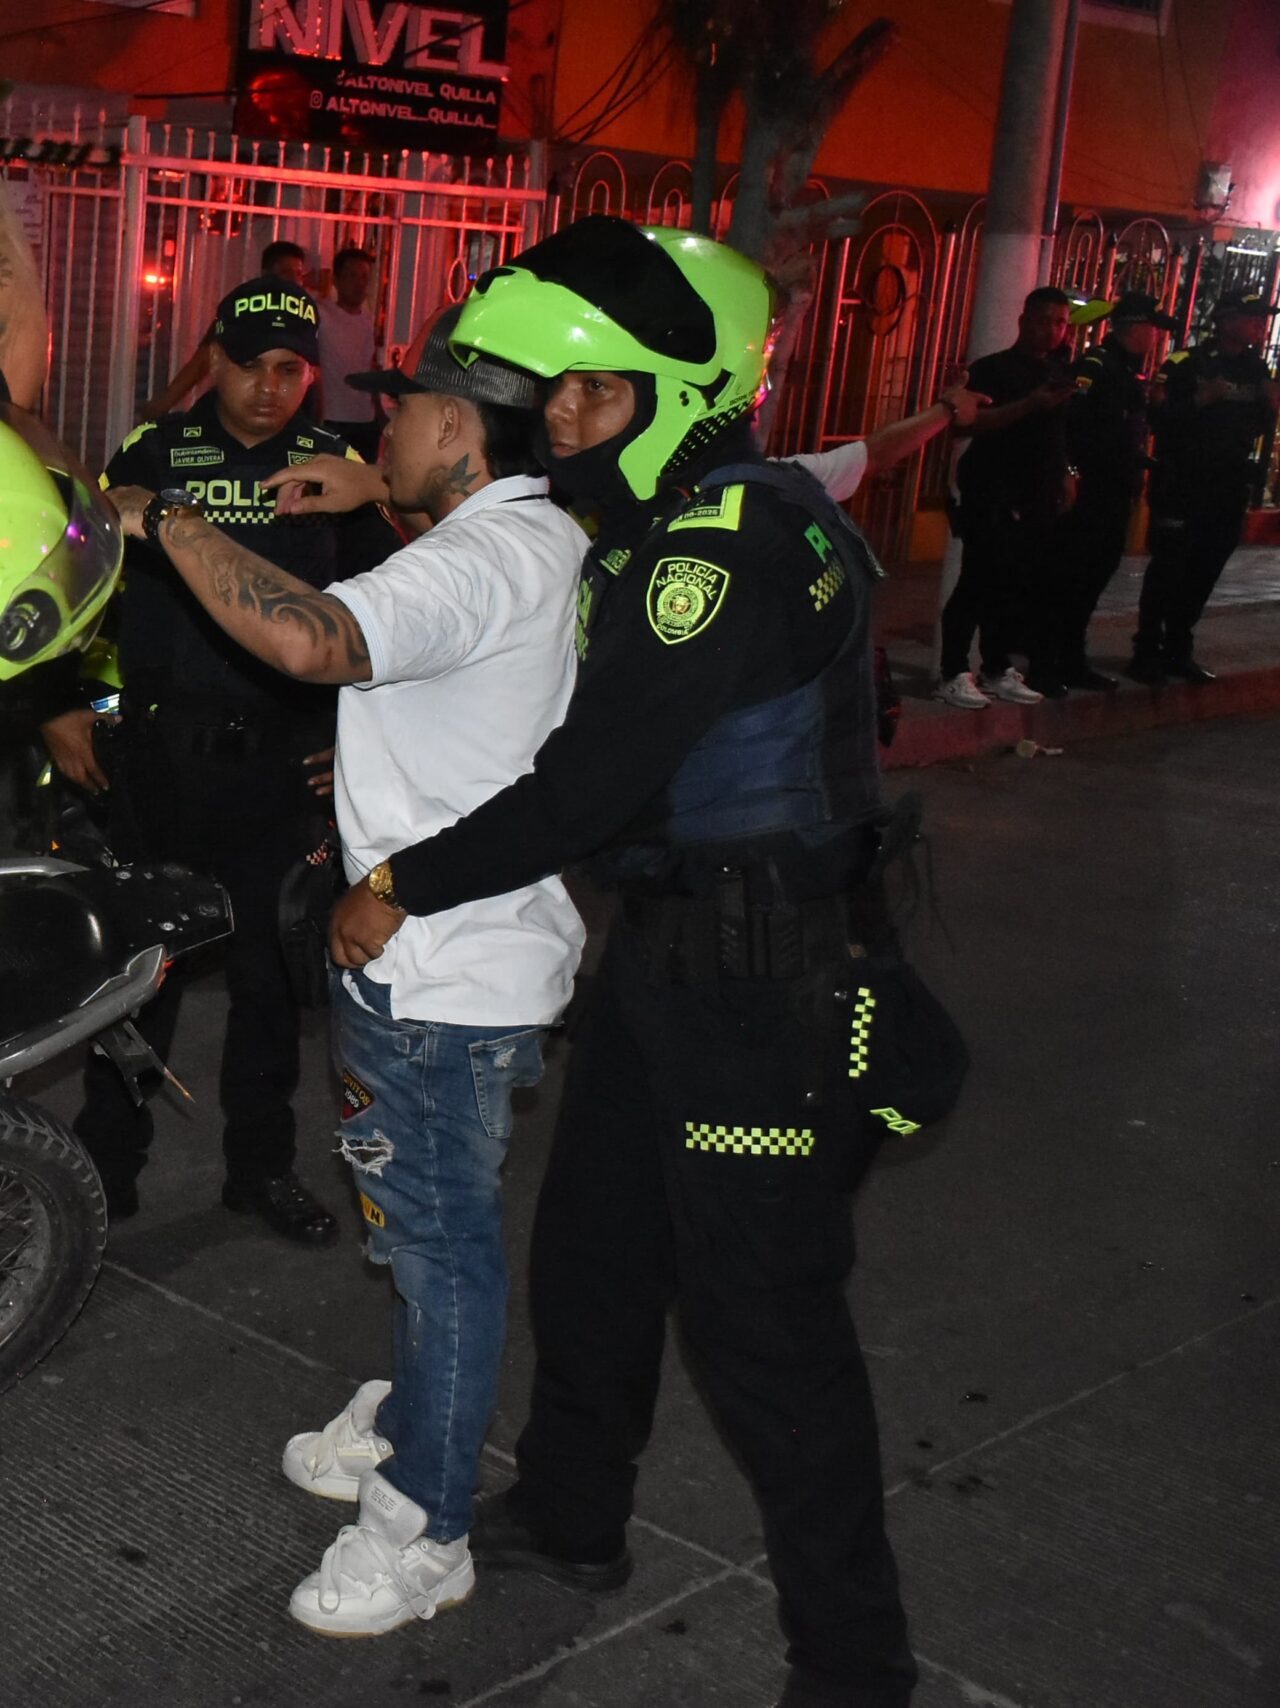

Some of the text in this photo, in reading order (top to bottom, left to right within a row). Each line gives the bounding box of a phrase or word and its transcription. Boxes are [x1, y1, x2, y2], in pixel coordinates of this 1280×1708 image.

[250, 0, 510, 78] NIVEL
[345, 74, 497, 104] ALTONIVEL QUILLA
[235, 292, 316, 325] POLICÍA
[656, 572, 718, 600] NACIONAL
[667, 562, 718, 585] POLICÍA
